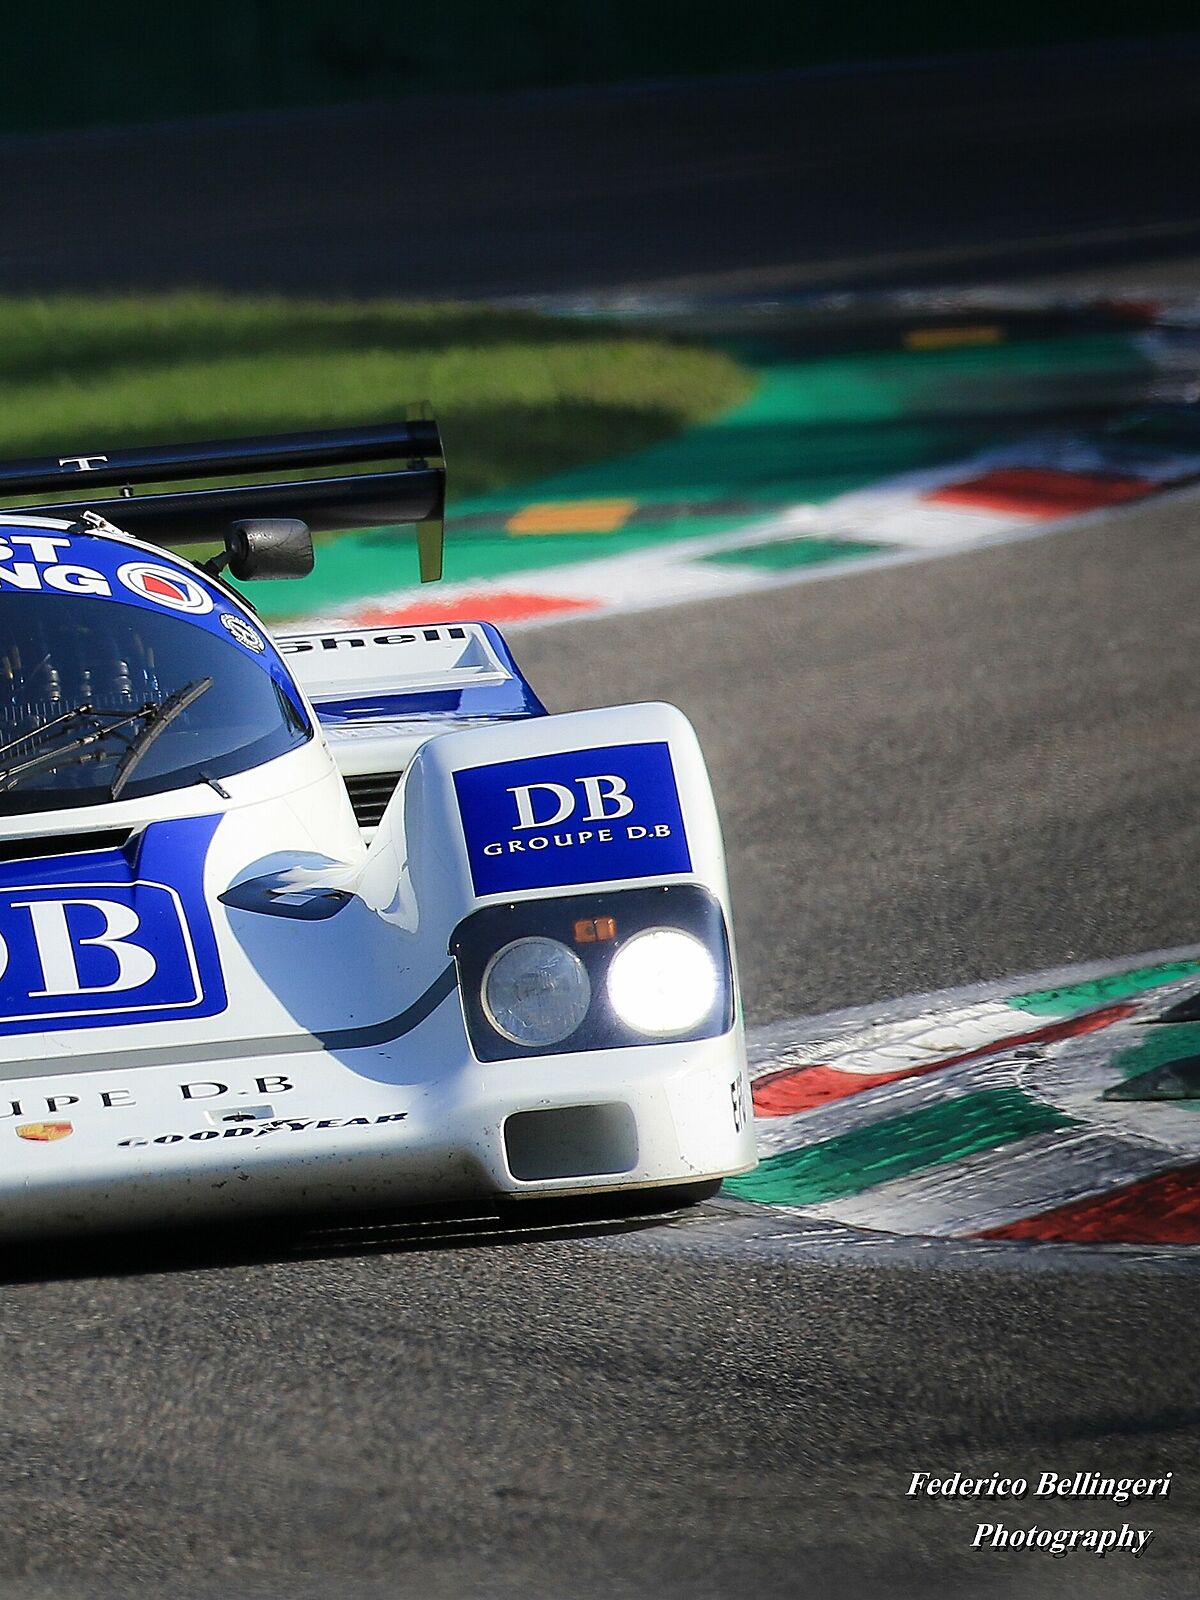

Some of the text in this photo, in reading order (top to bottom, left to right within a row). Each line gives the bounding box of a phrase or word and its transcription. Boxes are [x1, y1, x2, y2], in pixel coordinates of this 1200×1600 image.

[506, 775, 634, 830] DB
[483, 824, 671, 856] GROUPE D.B
[180, 1075, 296, 1101] D.B
